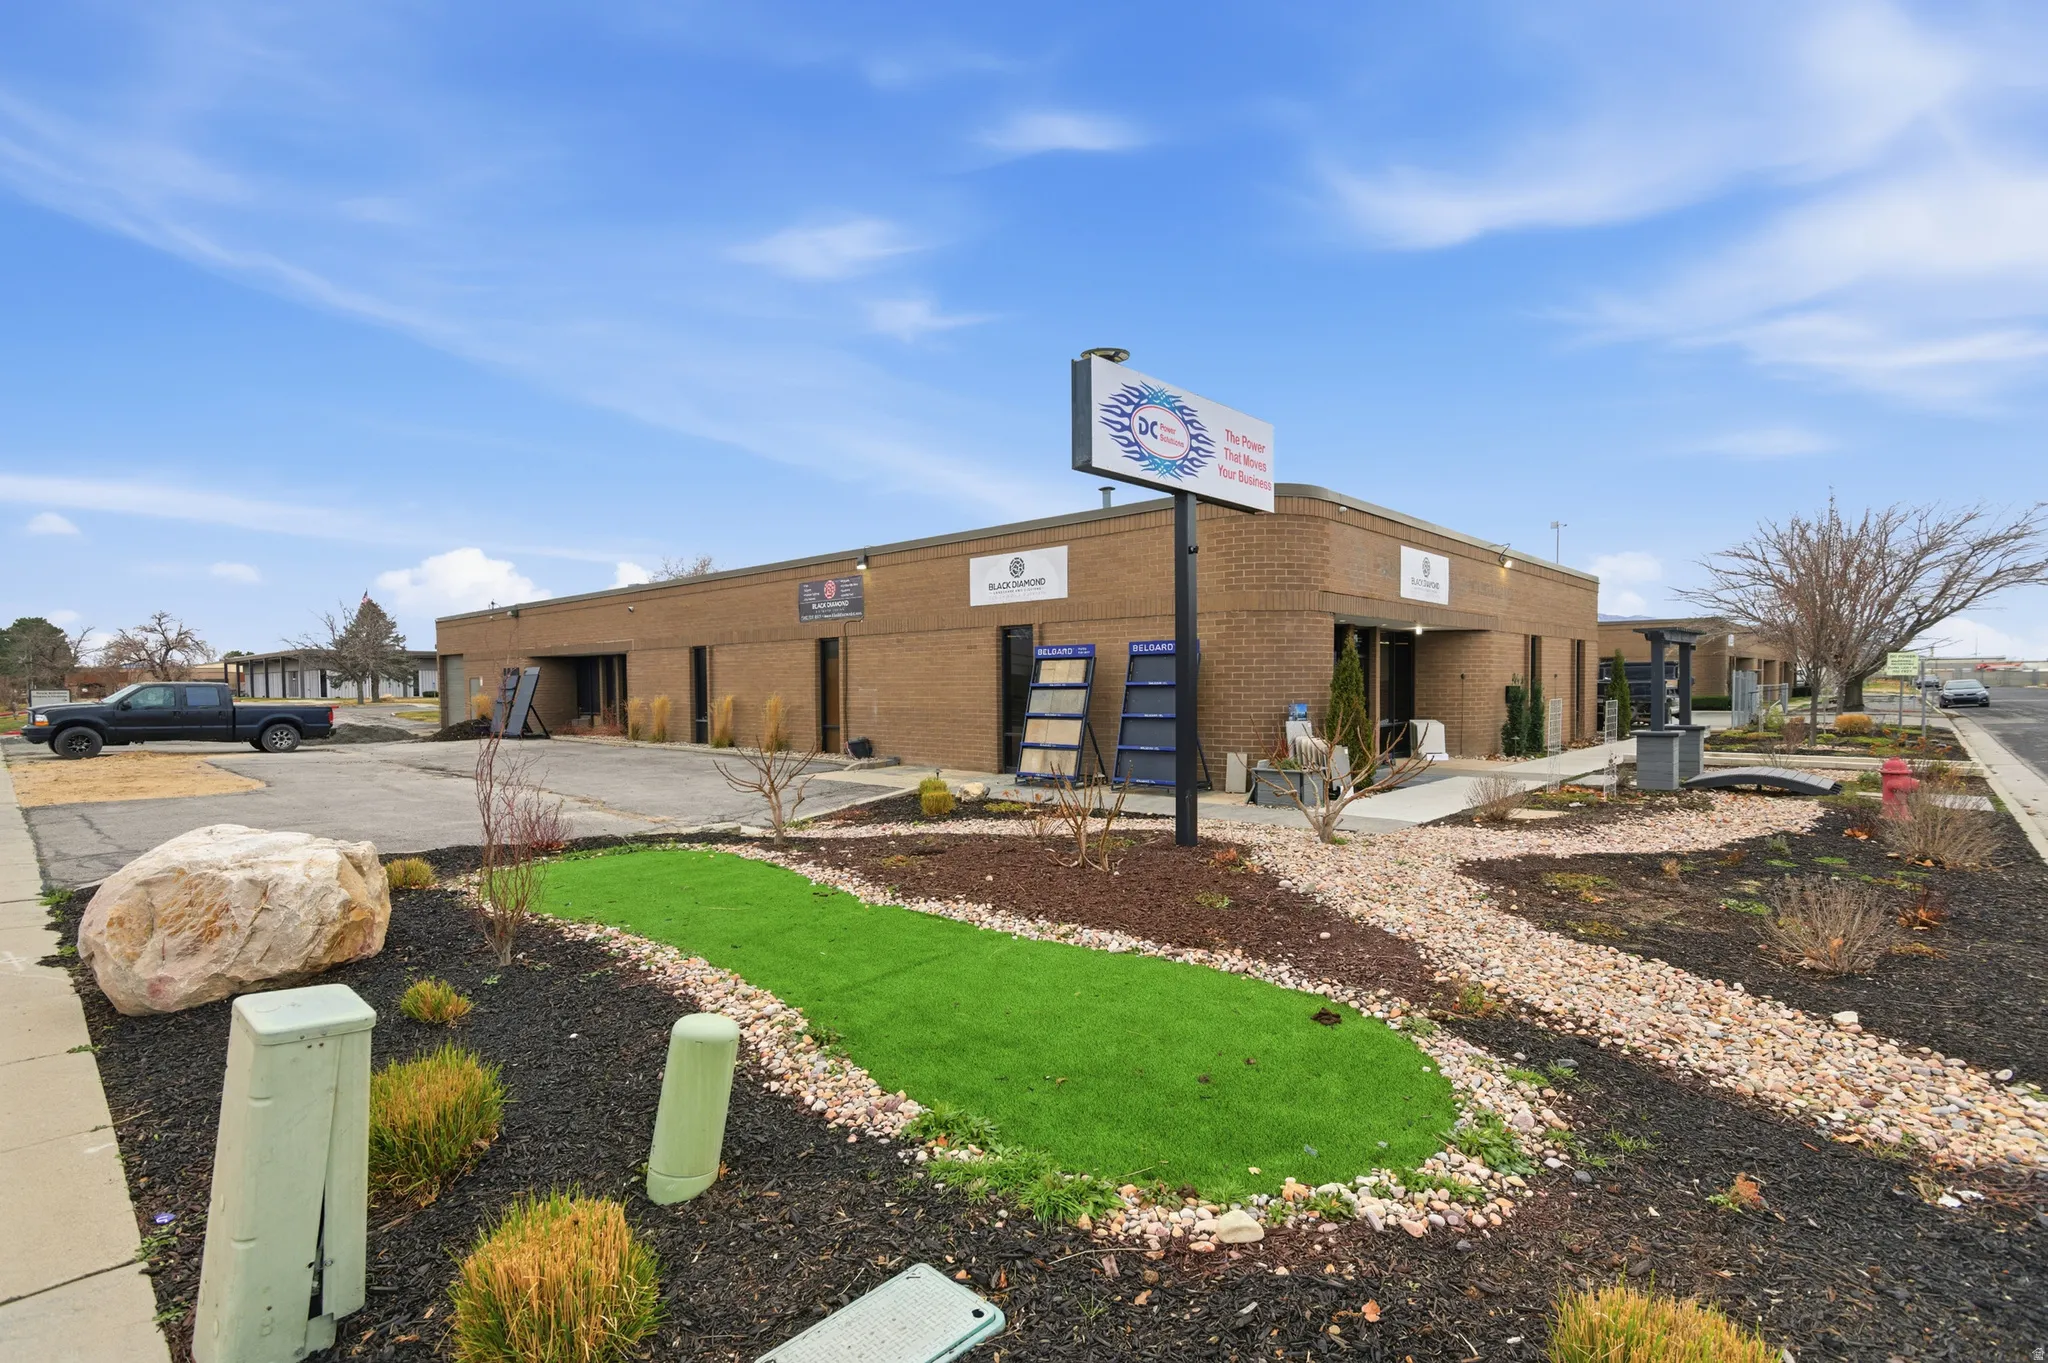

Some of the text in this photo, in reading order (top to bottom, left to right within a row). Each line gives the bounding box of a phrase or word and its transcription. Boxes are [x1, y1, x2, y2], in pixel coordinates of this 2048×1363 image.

[1138, 415, 1158, 440] DC
[1225, 428, 1266, 453] The Power
[1224, 447, 1267, 472] That Moves
[1218, 463, 1272, 491] Your Business
[988, 581, 1011, 591] BLACK
[1011, 577, 1046, 589] DIAMOND
[1037, 648, 1073, 656] BELGARD
[1132, 643, 1174, 652] BELGARD
